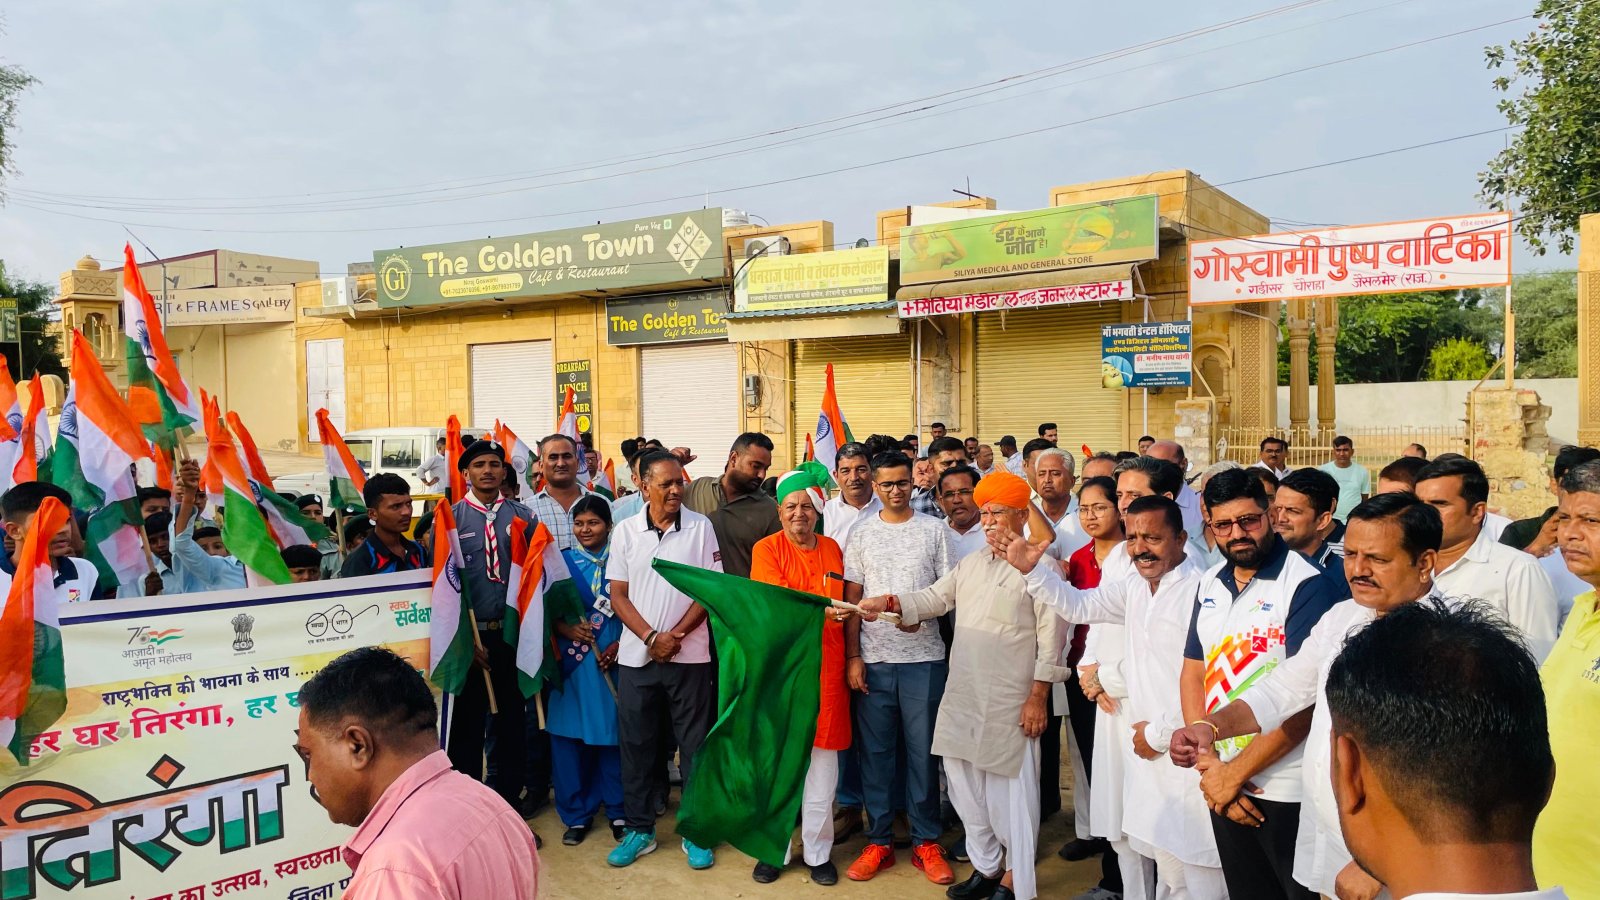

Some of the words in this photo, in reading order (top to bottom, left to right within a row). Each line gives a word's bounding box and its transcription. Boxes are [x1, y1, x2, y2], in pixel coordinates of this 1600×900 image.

[421, 251, 468, 279] The
[478, 240, 573, 274] Golden
[582, 232, 655, 262] Town
[1004, 236, 1038, 256] जीत
[1194, 235, 1322, 284] गोस्वामी
[1327, 240, 1385, 282] पुष्प
[1386, 222, 1507, 267] वाटिका
[556, 267, 564, 280] &
[568, 263, 631, 280] Restaurant
[953, 267, 976, 277] SILIYA
[976, 265, 1010, 275] MEDICAL
[1011, 263, 1029, 272] AND
[1030, 260, 1066, 269] GENERAL
[1068, 255, 1094, 265] STORE
[385, 267, 406, 290] GT
[1352, 273, 1398, 288] जैसलमेर
[155, 302, 172, 314] RT
[176, 303, 183, 313] &
[186, 299, 251, 313] FRAMES
[252, 297, 291, 311] GALLERY
[1038, 286, 1078, 304] जनरल
[610, 315, 637, 333] The
[642, 312, 697, 331] Golden
[702, 308, 728, 325] To
[556, 360, 590, 374] BREAKFAST
[559, 382, 588, 394] LUNCH
[559, 403, 590, 415] NER
[394, 602, 432, 627] सर्वेक्ष
[133, 657, 156, 669] अमृत
[159, 652, 192, 665] महोत्सव
[101, 680, 172, 708] राष्ट्रभक्ति
[177, 674, 195, 694] की
[199, 674, 243, 691] भावना
[246, 666, 259, 684] के
[263, 666, 290, 681] साथ
[29, 729, 62, 759] हर
[73, 719, 121, 747] घर
[129, 701, 235, 741] तिरंगा,
[245, 694, 278, 718] हर
[286, 691, 301, 709] घ
[0, 752, 290, 900] तिरंगा
[211, 868, 268, 898] उत्सव,
[274, 845, 341, 879] स्वच्छता
